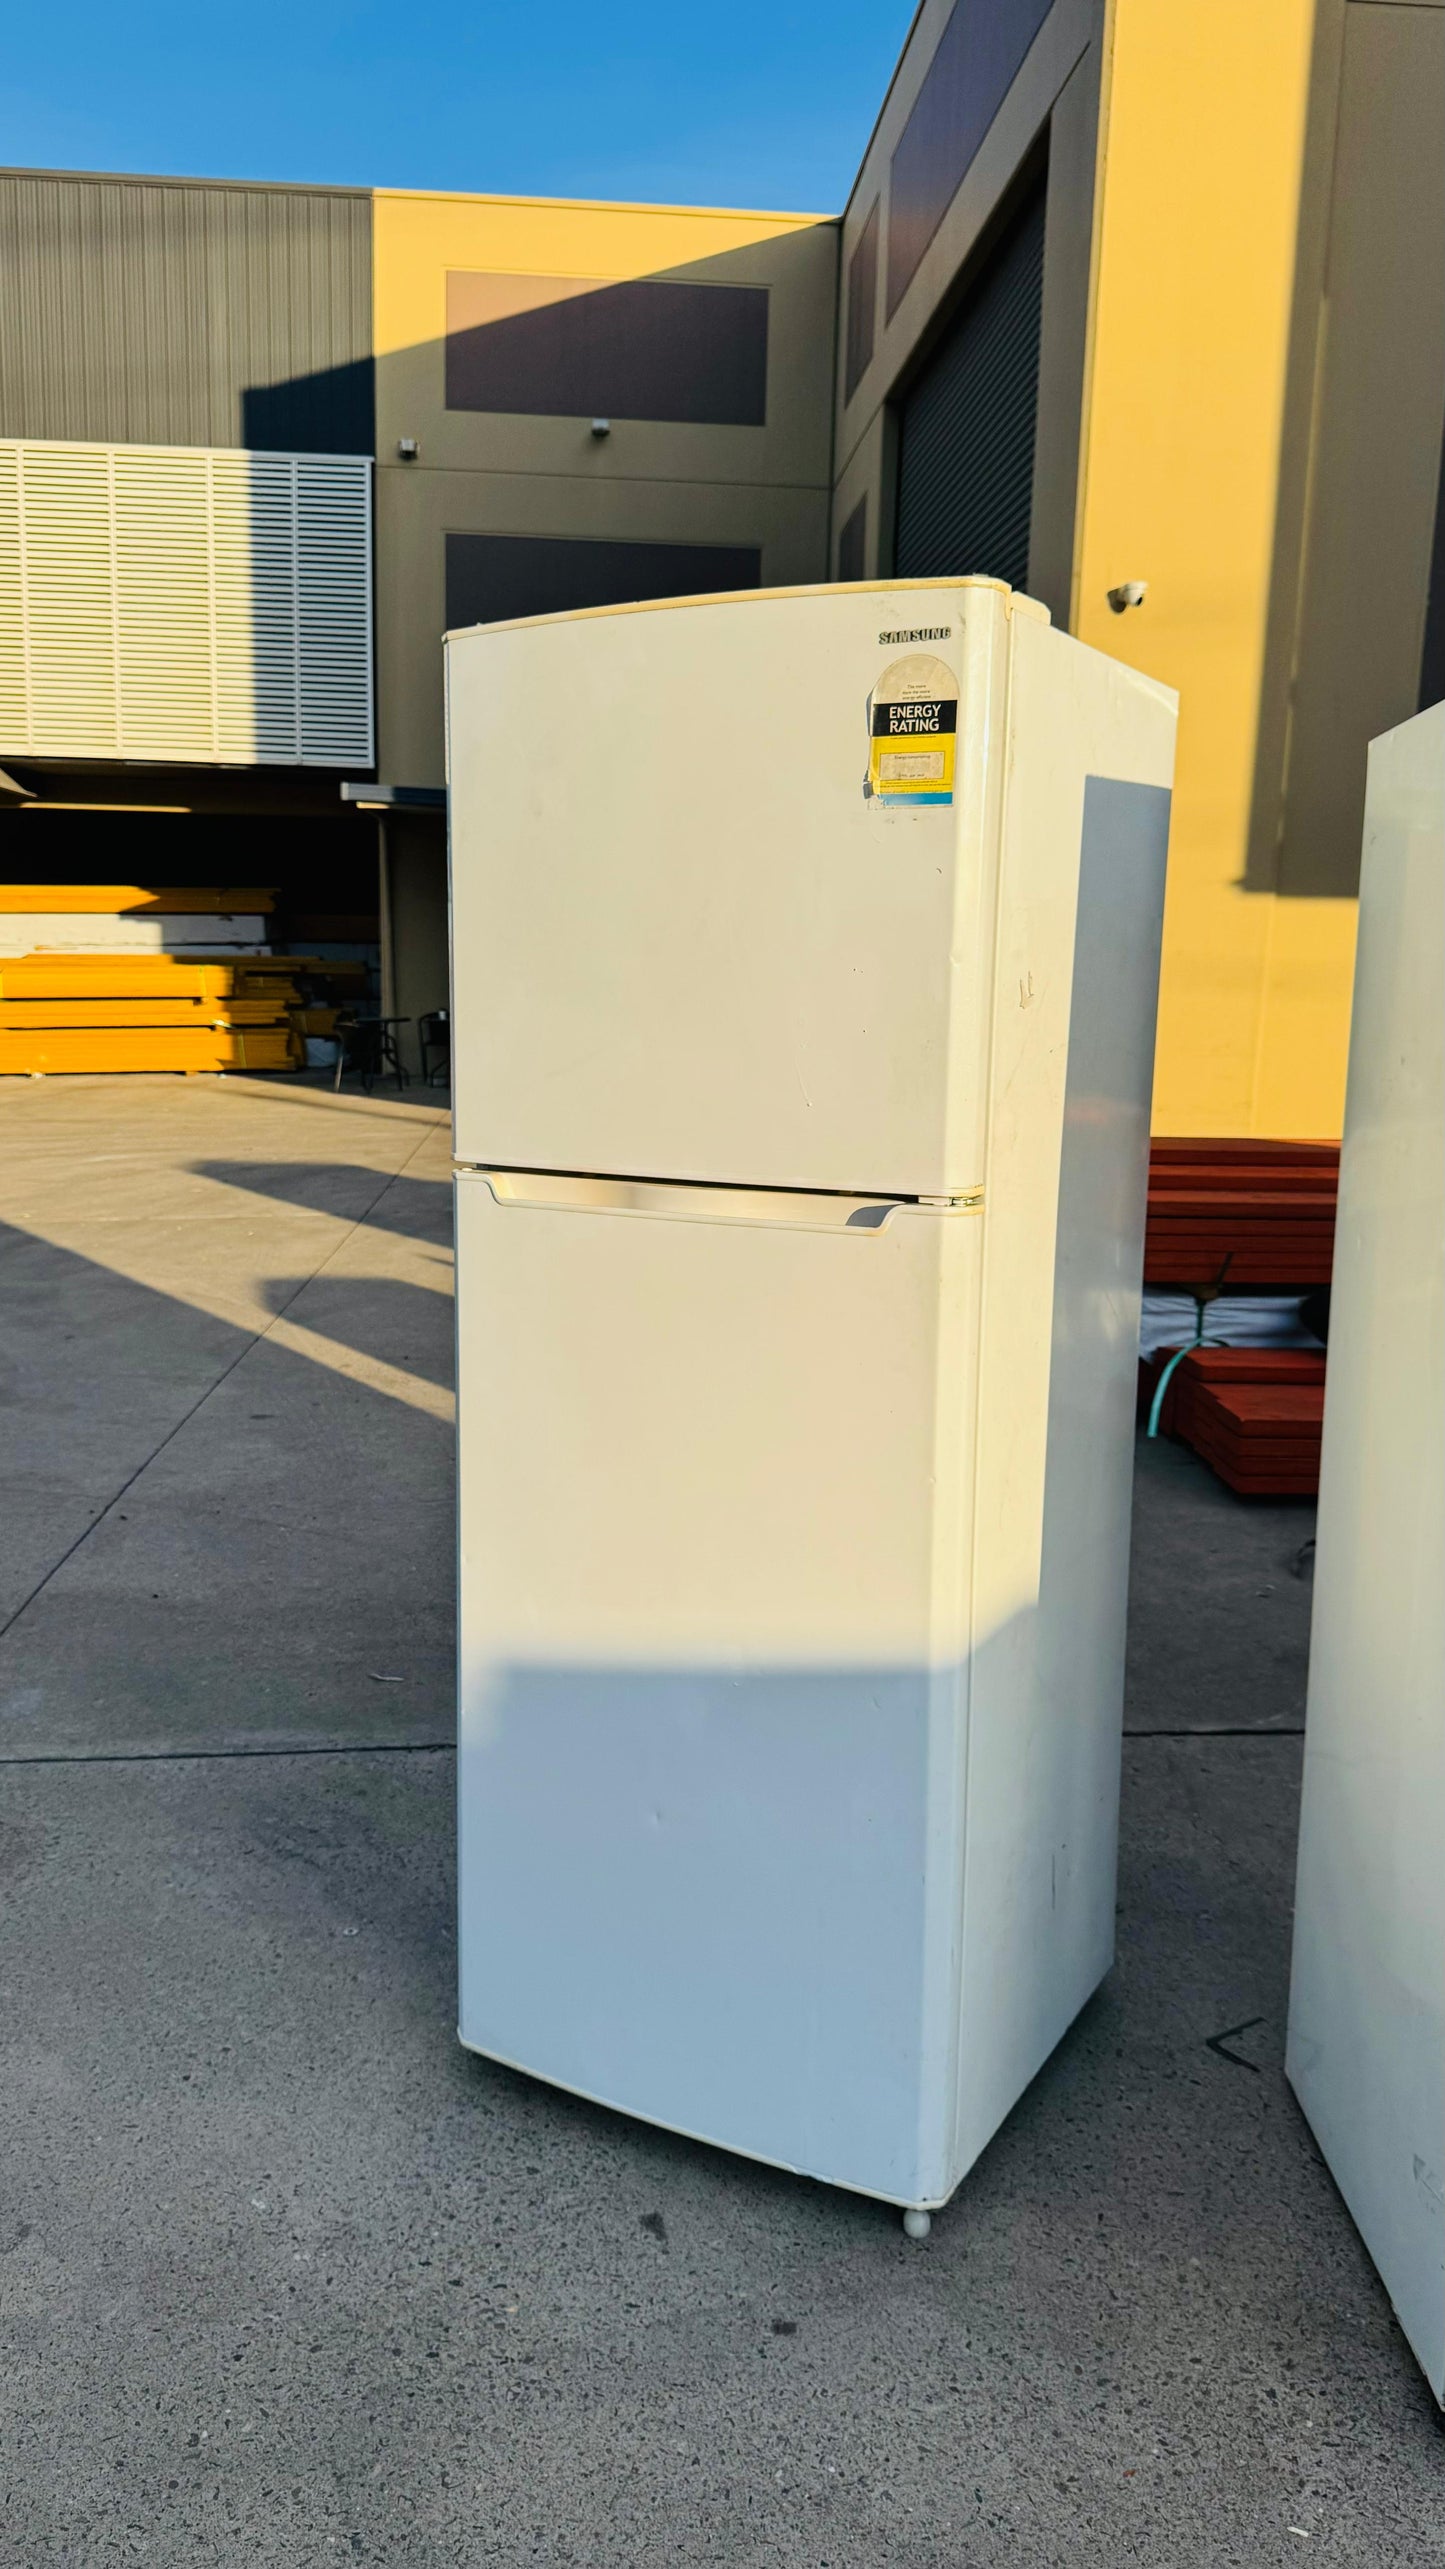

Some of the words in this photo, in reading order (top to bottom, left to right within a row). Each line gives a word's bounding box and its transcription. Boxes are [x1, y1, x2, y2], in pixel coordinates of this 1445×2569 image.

[879, 627, 951, 645] SAMSUNG
[889, 704, 941, 719] ENERGY
[889, 718, 939, 733] RATING
